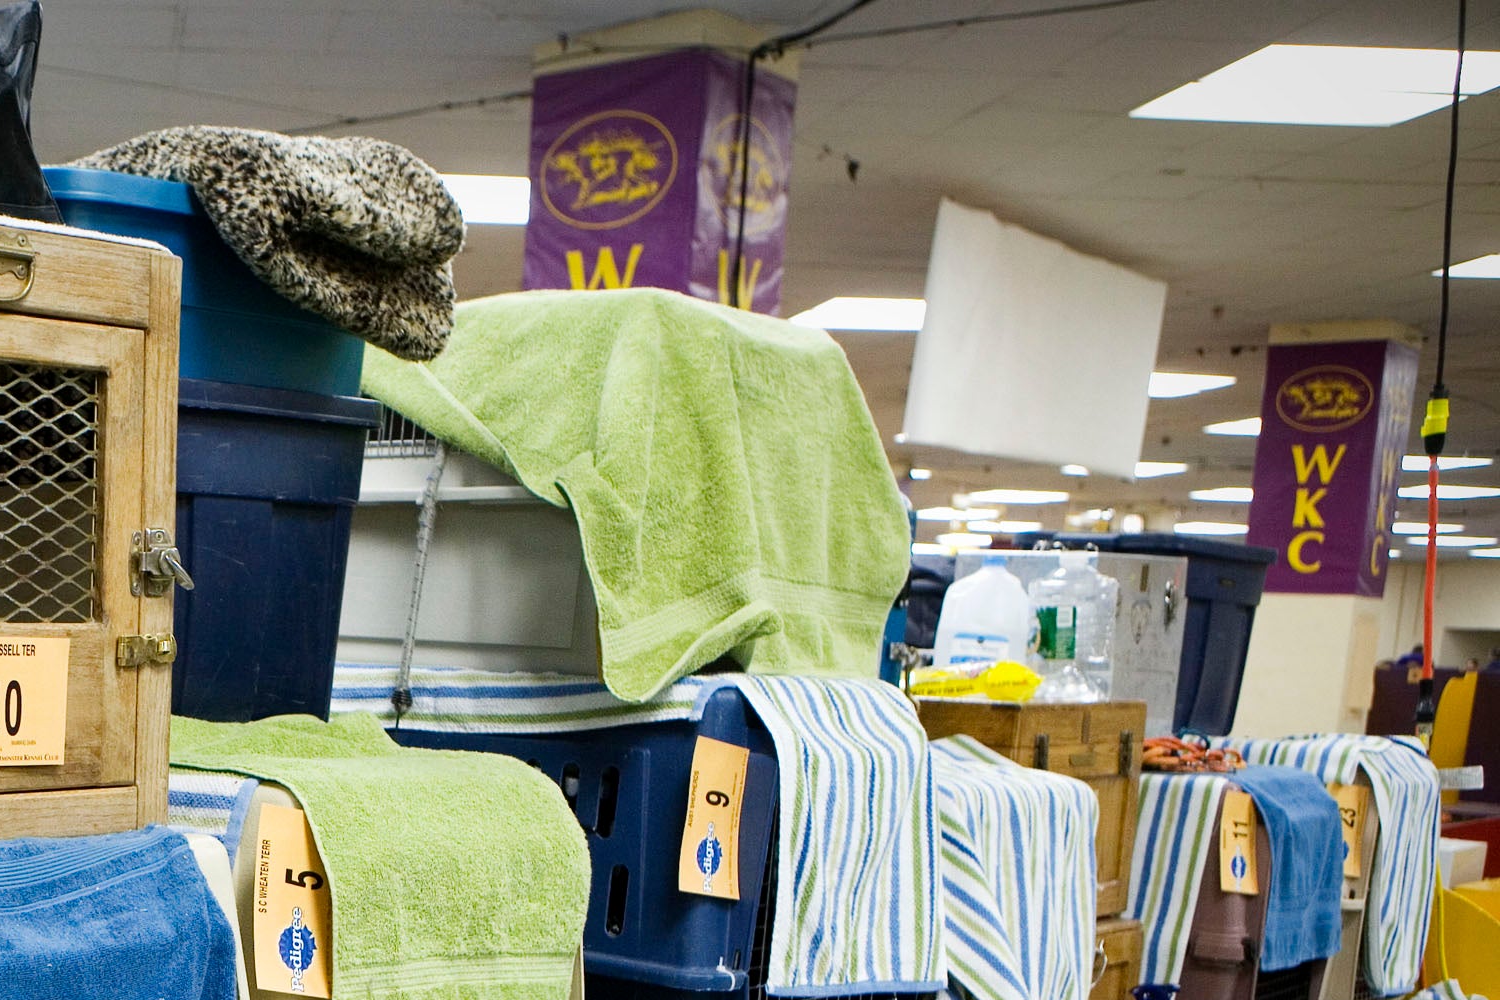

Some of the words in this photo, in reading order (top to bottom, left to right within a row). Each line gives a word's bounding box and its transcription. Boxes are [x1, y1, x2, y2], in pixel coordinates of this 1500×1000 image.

[566, 244, 644, 290] W
[22, 644, 36, 657] TER
[705, 790, 730, 808] 9
[1232, 820, 1248, 838] 11
[261, 839, 271, 859] TERR
[258, 862, 269, 899] WHEATEN
[285, 868, 324, 890] 5
[289, 906, 305, 992] Pedigree
